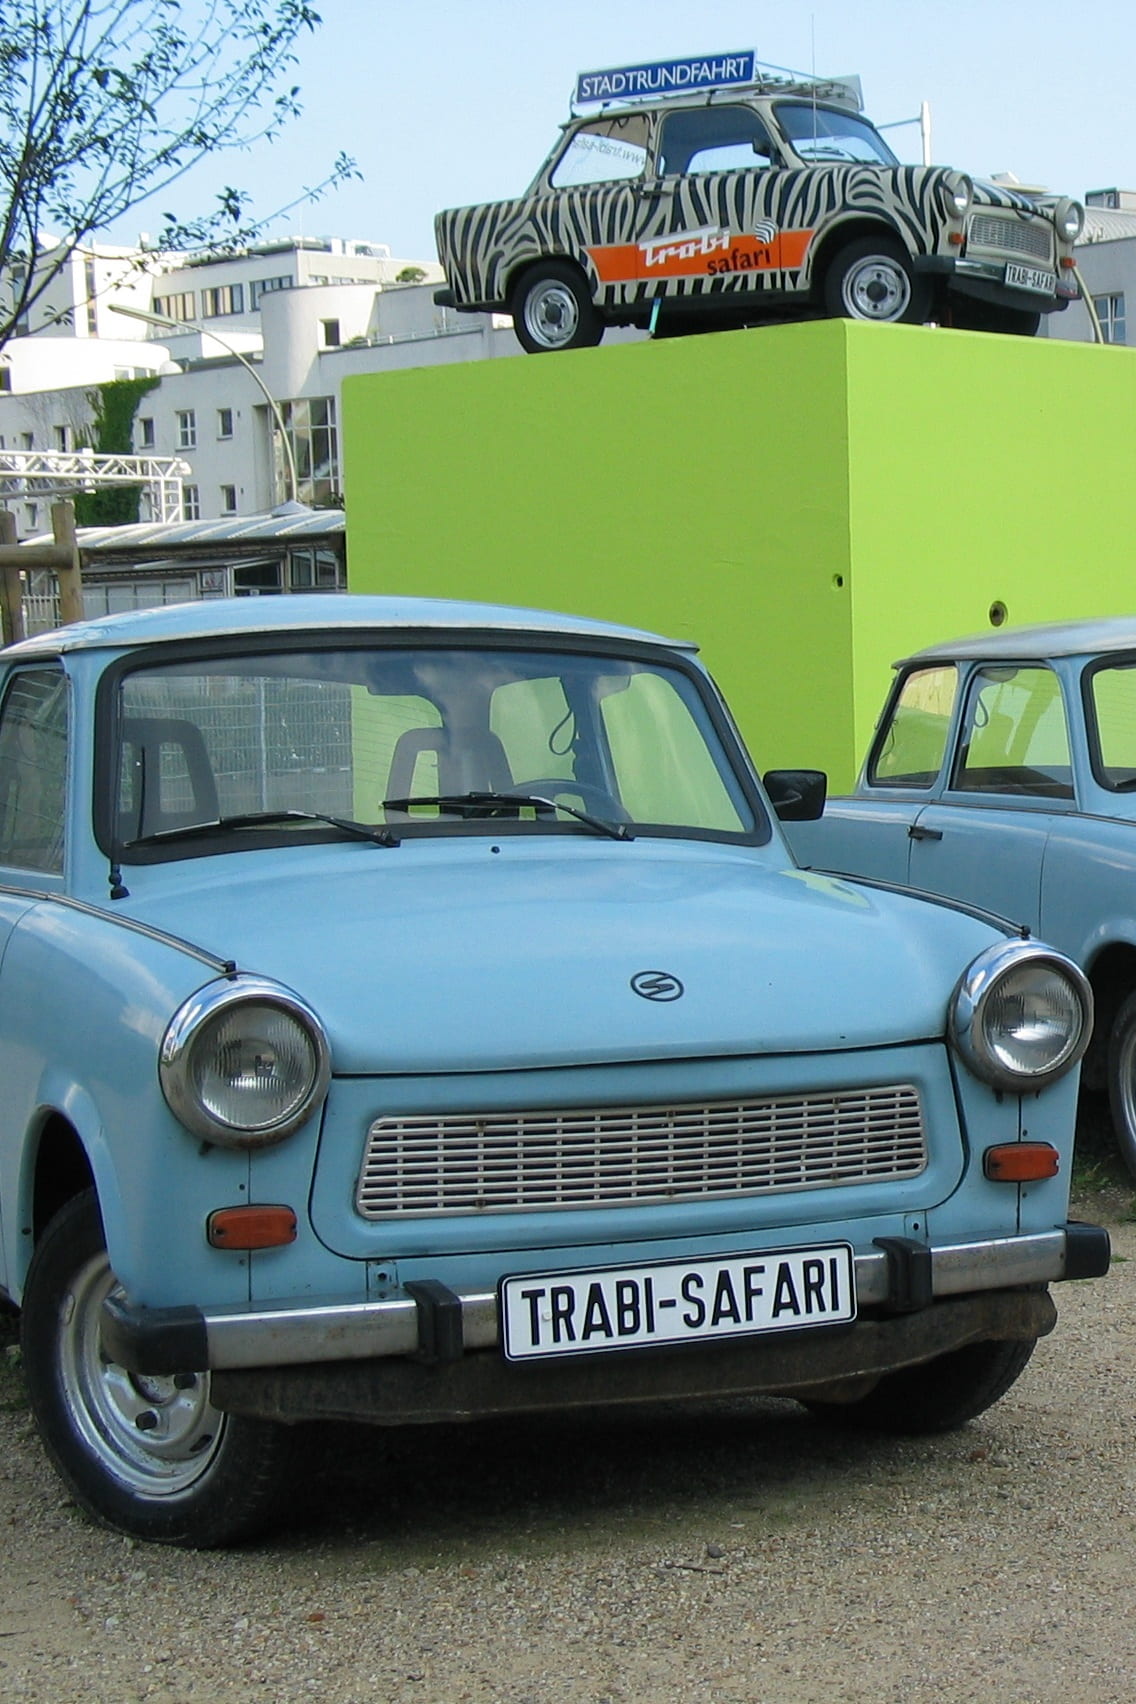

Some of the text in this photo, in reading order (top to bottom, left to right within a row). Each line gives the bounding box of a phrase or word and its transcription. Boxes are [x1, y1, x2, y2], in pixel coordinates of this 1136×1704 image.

[581, 56, 750, 97] STADTRUNDFAHRT
[706, 248, 771, 276] safari
[521, 1257, 840, 1346] TRABI-SAFARI
